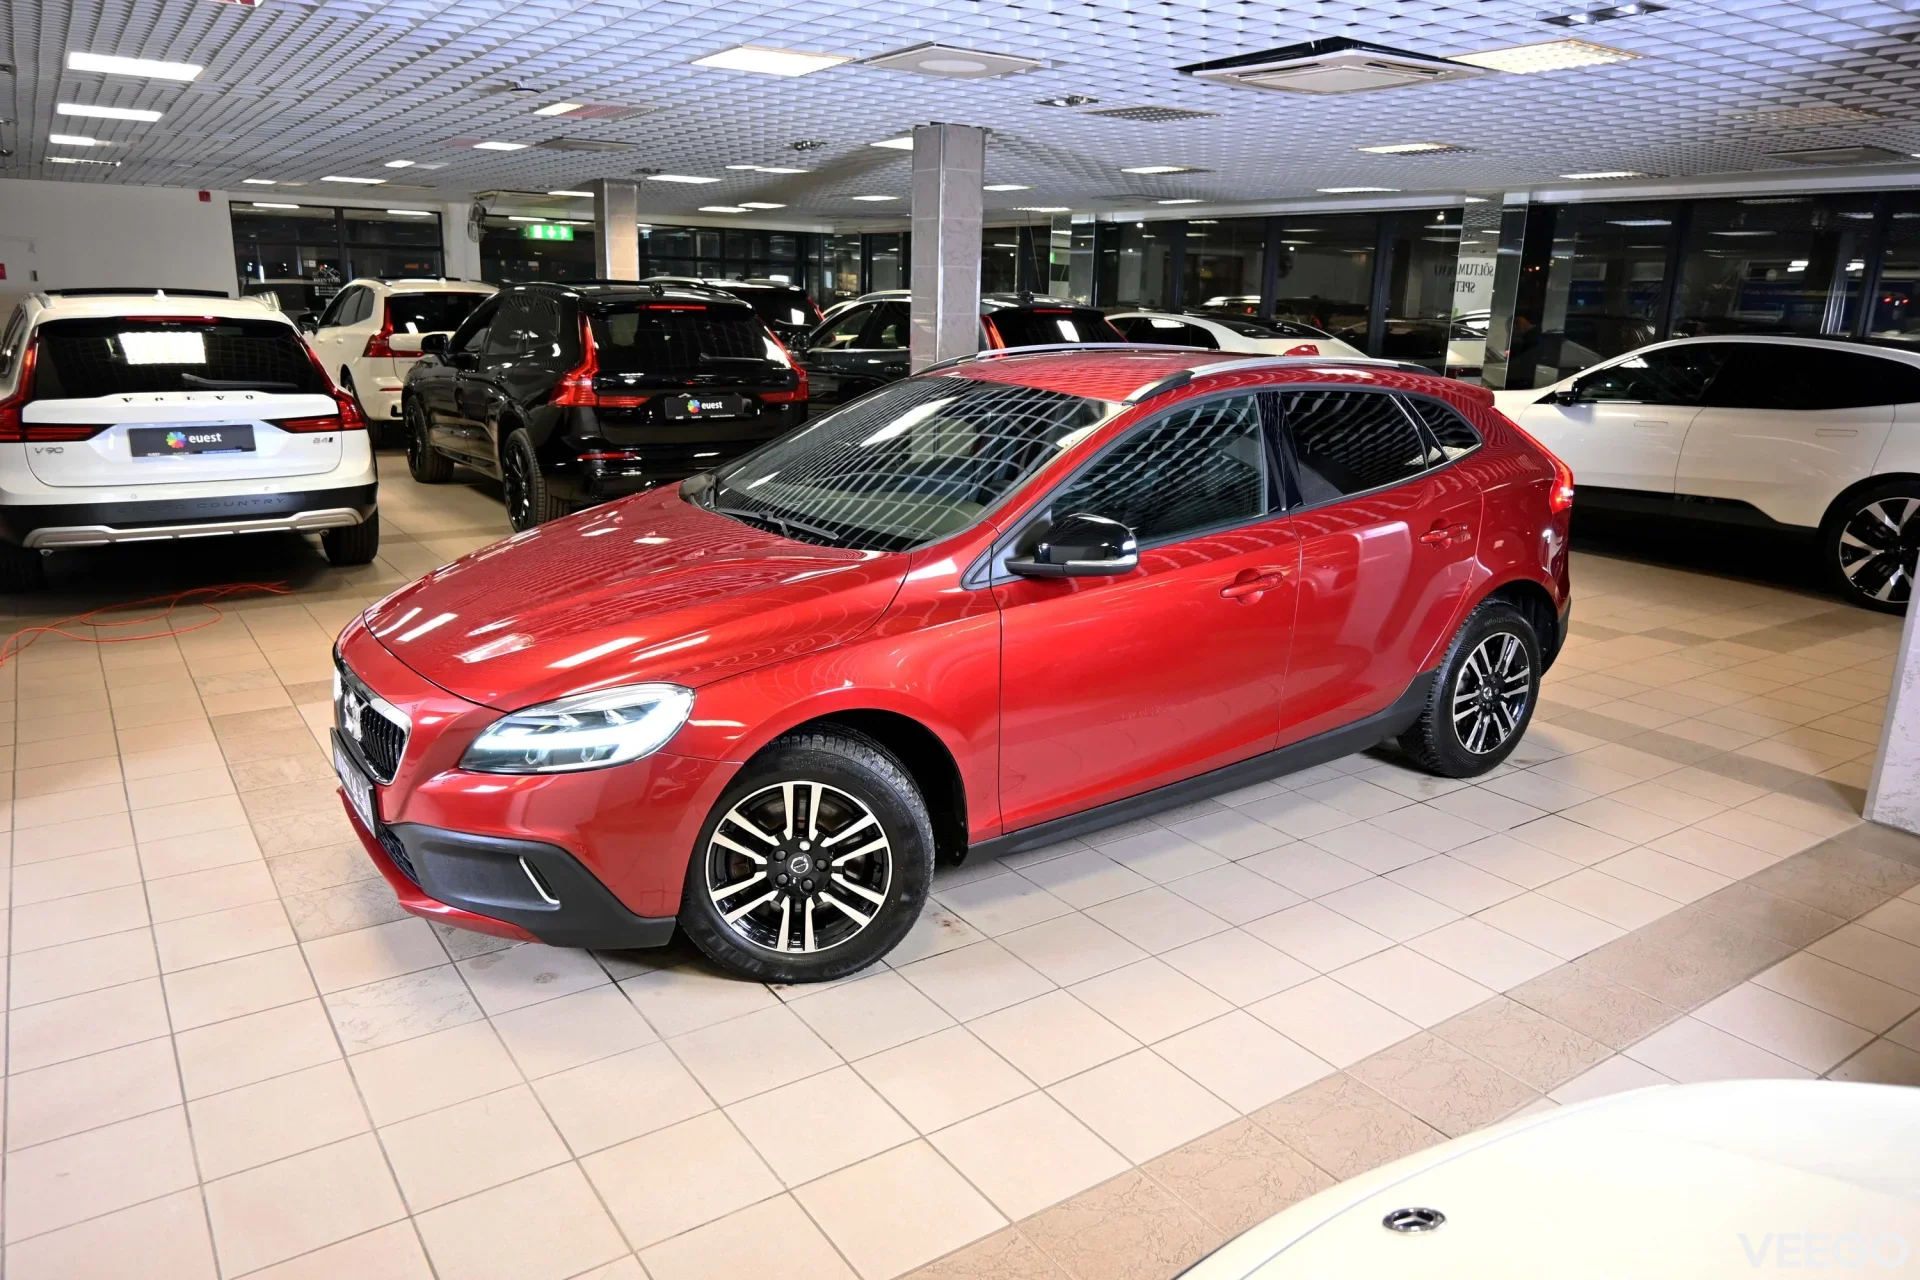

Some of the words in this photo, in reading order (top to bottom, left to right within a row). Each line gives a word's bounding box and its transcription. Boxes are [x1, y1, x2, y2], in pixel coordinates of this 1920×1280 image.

[121, 394, 254, 403] VOLVO
[701, 400, 723, 410] euest
[188, 432, 222, 444] euest
[34, 446, 64, 454] V90
[196, 497, 286, 509] COUNTRY
